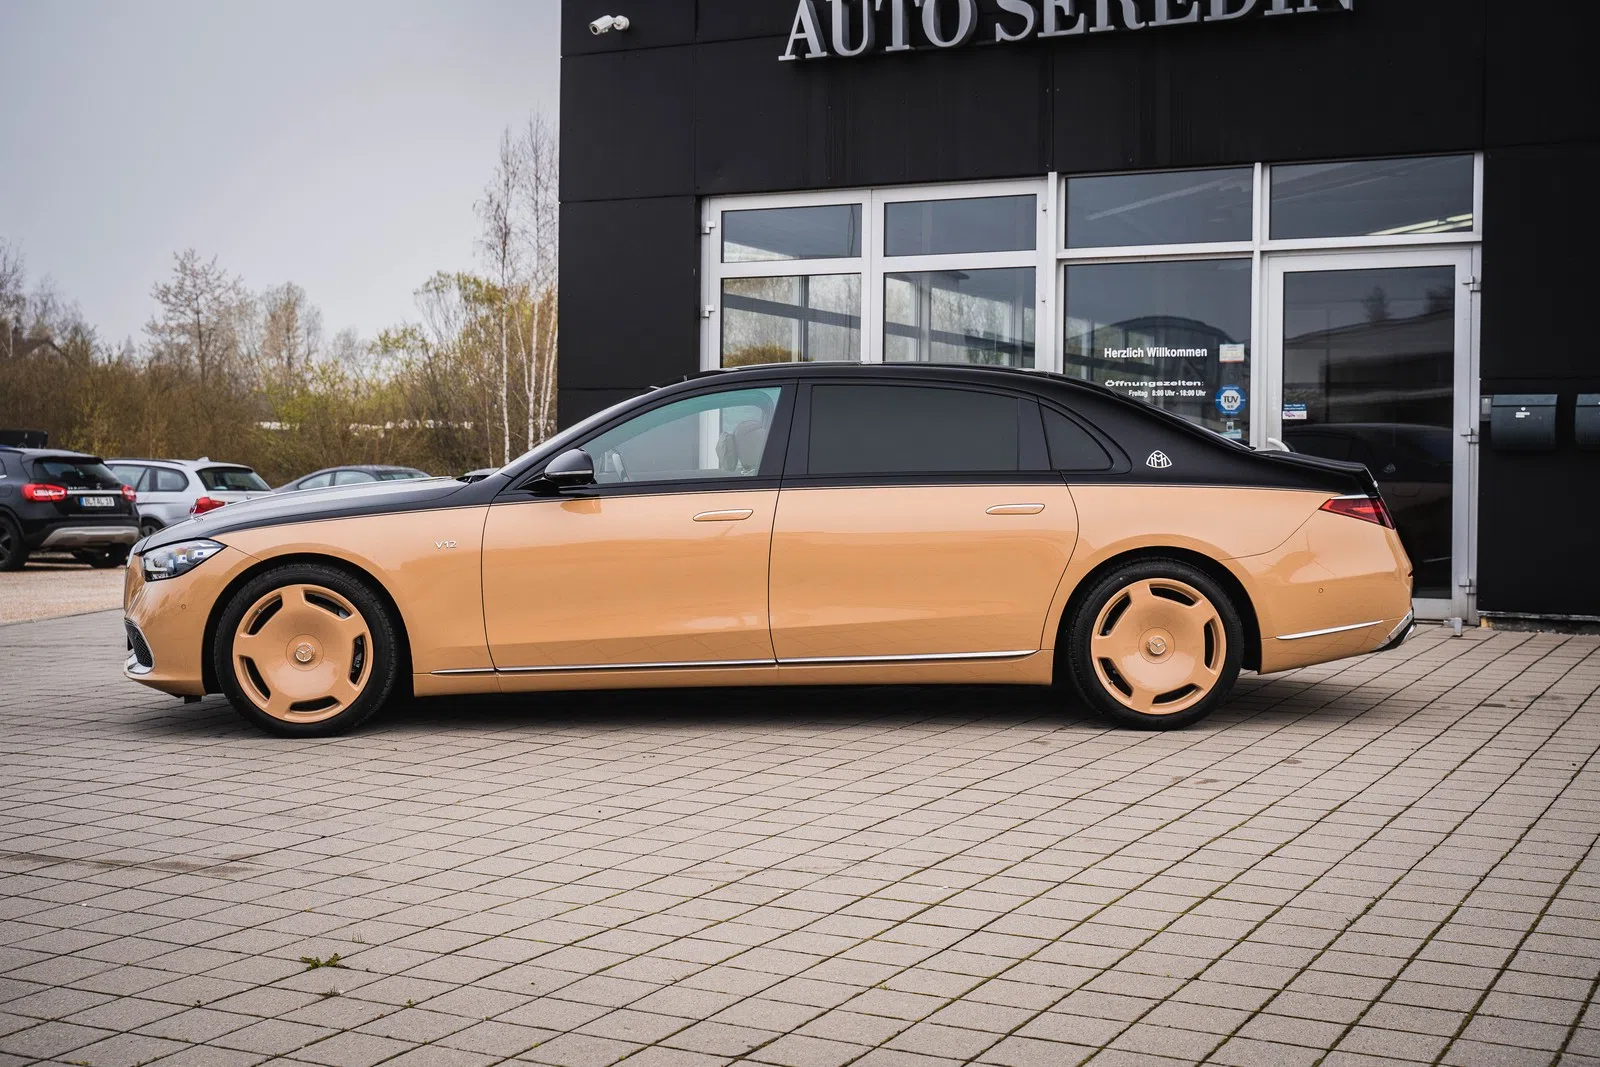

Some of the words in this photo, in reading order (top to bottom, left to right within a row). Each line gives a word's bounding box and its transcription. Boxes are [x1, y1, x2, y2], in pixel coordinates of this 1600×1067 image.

[778, 0, 975, 61] AUTO
[994, 0, 1353, 42] SERE
[1104, 347, 1144, 358] Herzlich
[1146, 346, 1208, 358] Willkommen
[1104, 379, 1204, 388] Öffnungszeiten:
[1164, 389, 1176, 397] Uhr
[433, 540, 457, 550] V12
